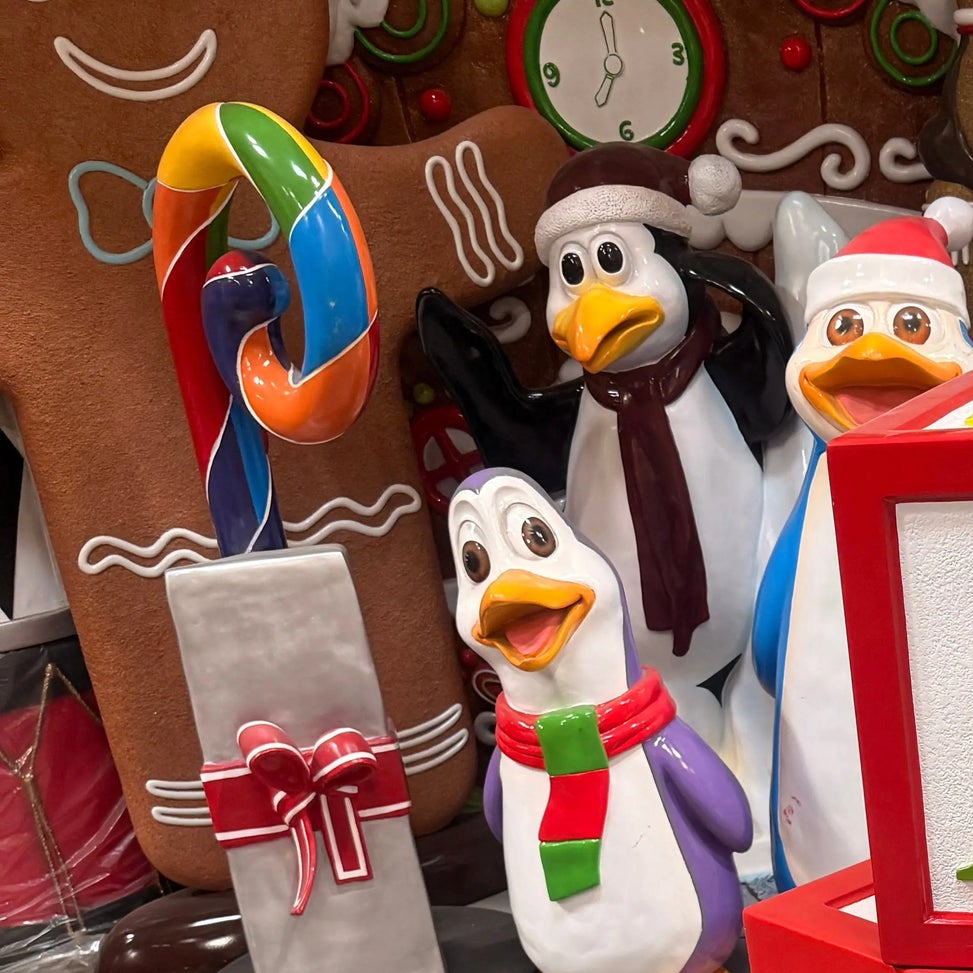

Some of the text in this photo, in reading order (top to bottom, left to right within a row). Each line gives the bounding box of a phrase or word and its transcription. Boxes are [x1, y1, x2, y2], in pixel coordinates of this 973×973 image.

[671, 42, 685, 66] 3
[543, 62, 560, 87] 9
[619, 120, 634, 141] 6
